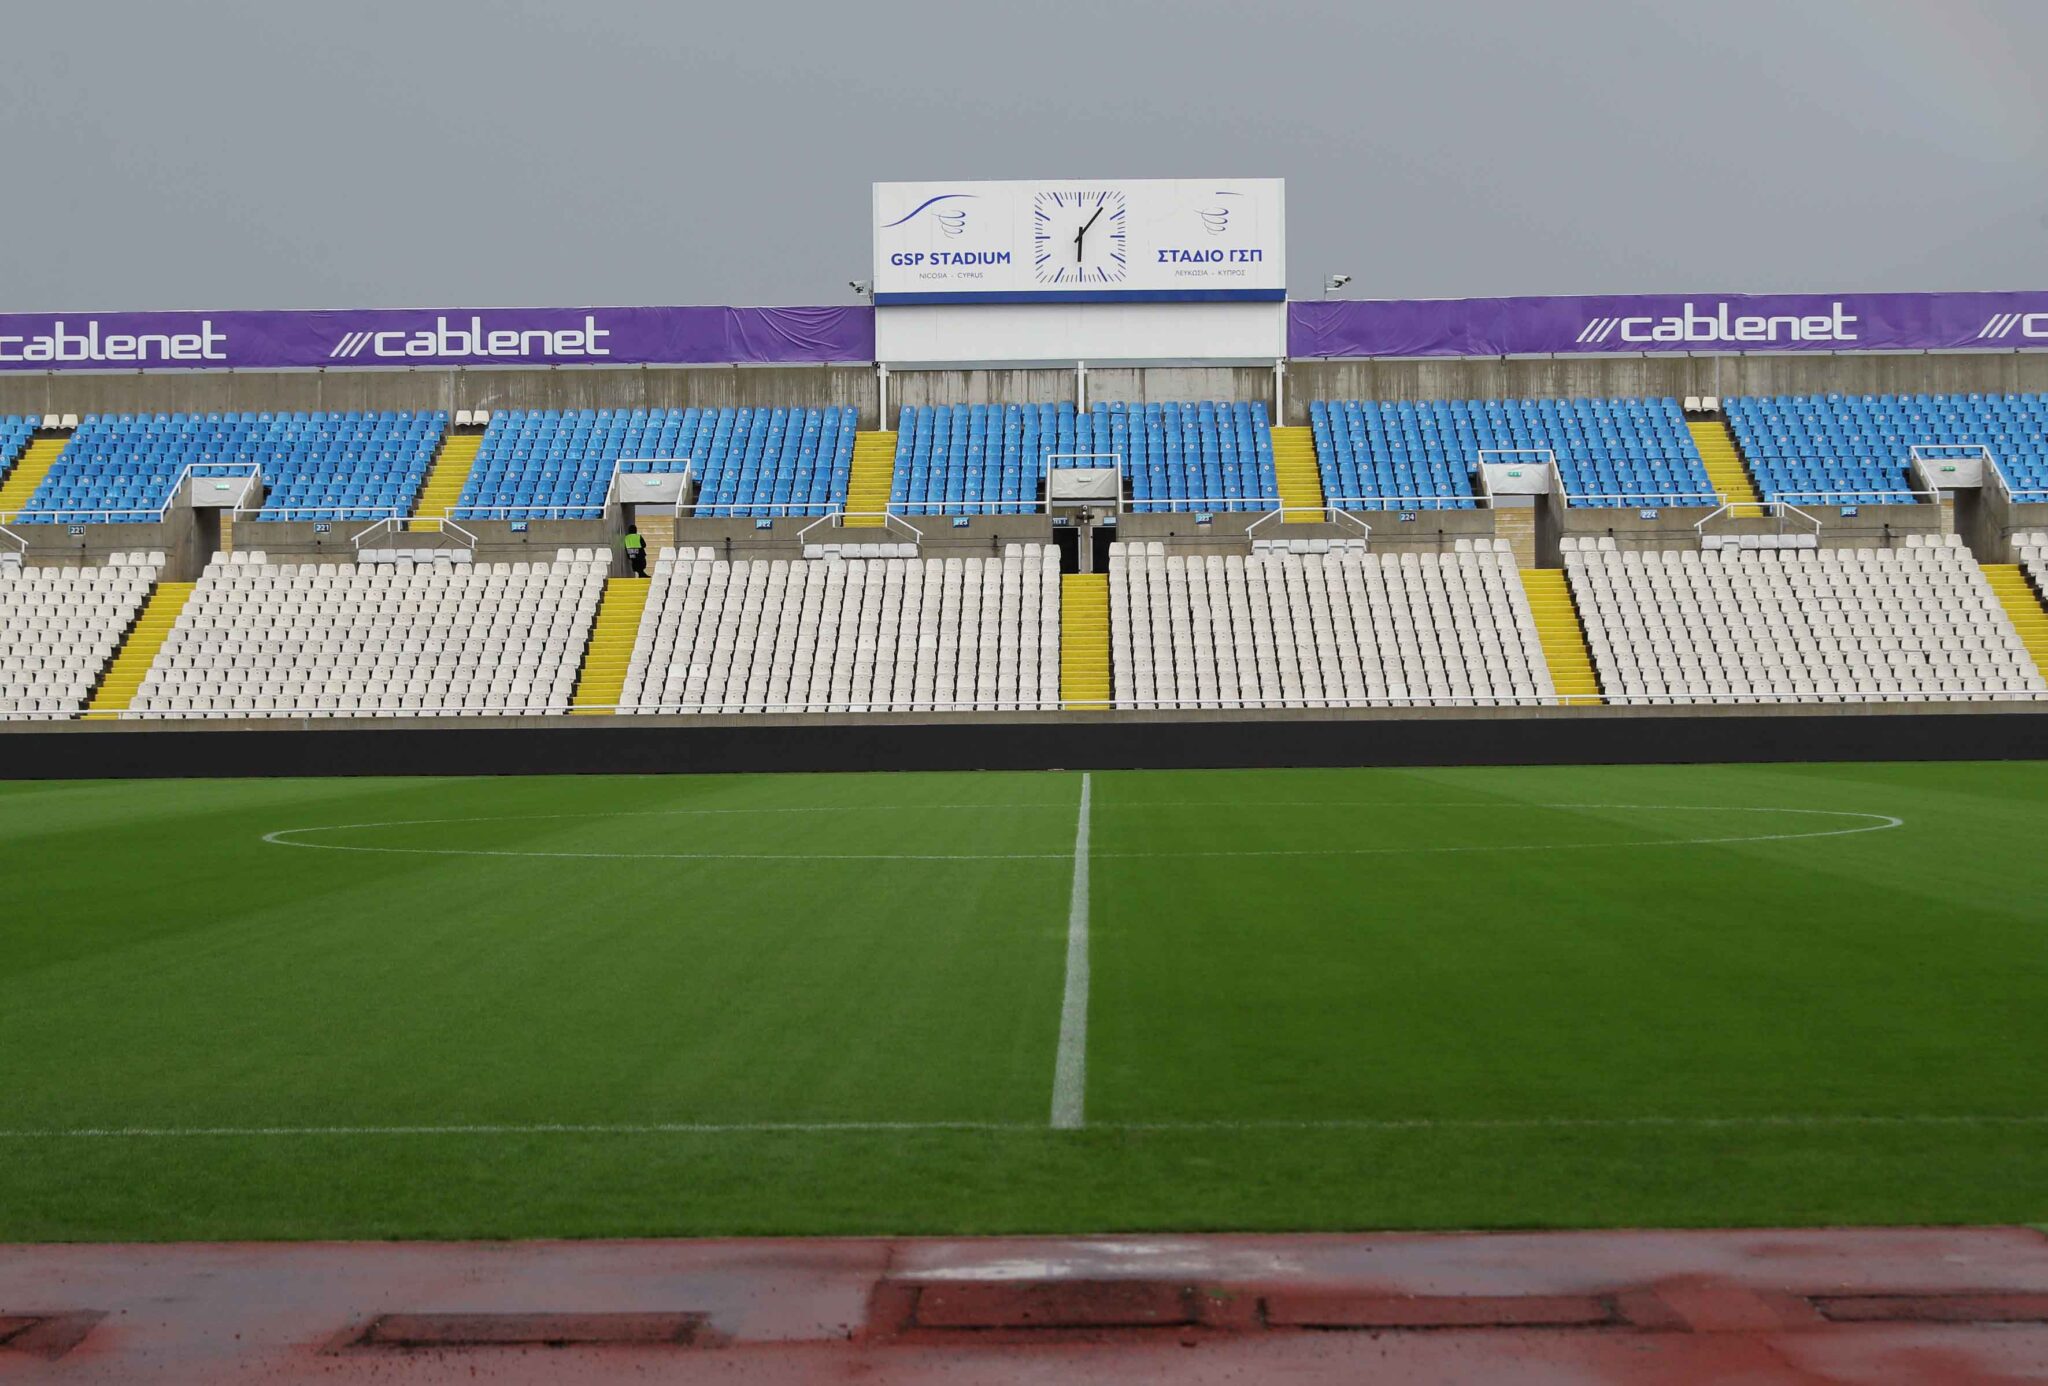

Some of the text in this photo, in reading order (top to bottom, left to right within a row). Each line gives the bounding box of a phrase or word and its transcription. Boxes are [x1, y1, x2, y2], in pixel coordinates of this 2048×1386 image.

[891, 251, 1011, 266] GSP STADIUM
[1158, 249, 1262, 263] ΣΤΑΔΙΟ ΓΣΠ
[1174, 269, 1209, 277] ΛΕΥΚΩΣΙΑ
[1620, 302, 1858, 342] cablenet
[0, 320, 227, 361] cablenet
[374, 315, 610, 357] cablenet
[1641, 511, 1656, 519] 224
